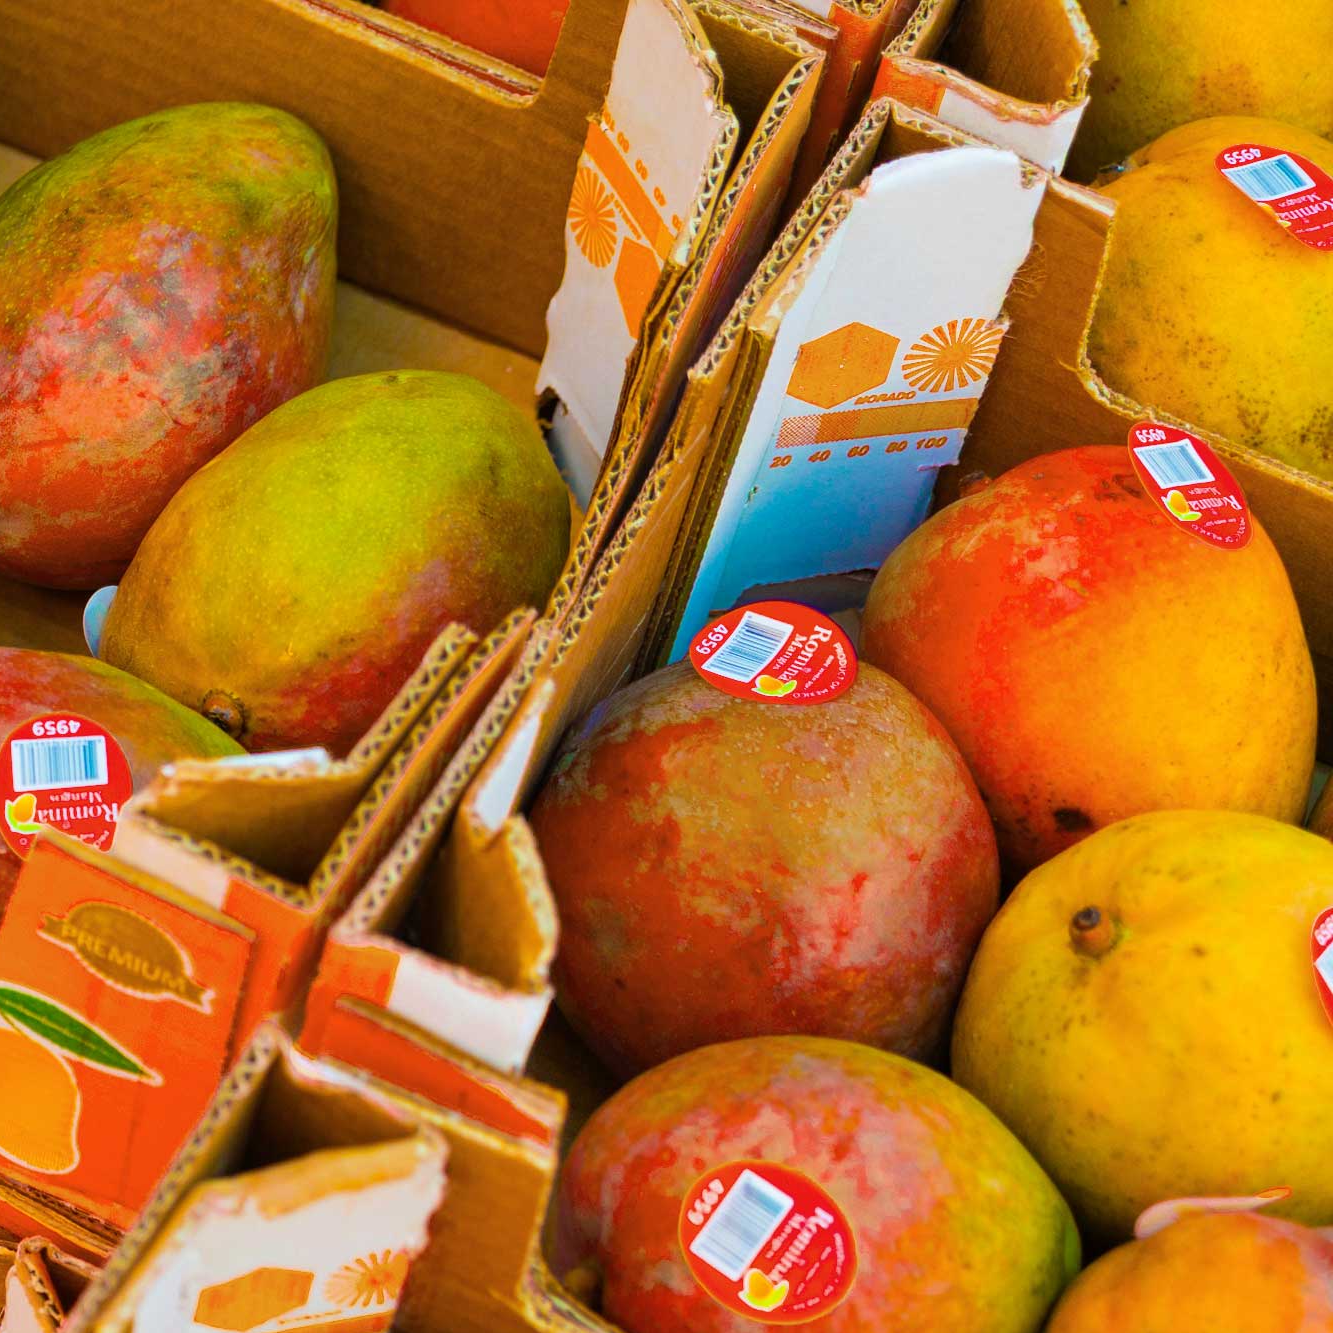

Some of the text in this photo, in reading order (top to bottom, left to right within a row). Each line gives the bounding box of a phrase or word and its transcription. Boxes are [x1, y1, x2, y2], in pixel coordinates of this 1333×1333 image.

[1223, 148, 1261, 165] 4959
[1135, 428, 1166, 443] 4959
[769, 436, 949, 469] 20 40 60 80 100
[1188, 495, 1242, 511] Romina
[695, 624, 729, 655] 4959
[772, 633, 808, 670] Mangos
[778, 625, 833, 681] Romina
[833, 642, 848, 681] PRODUCT
[32, 720, 81, 736] 4959
[50, 791, 102, 803] Mangos
[37, 803, 118, 823] Romina
[61, 922, 186, 991] PREMIUM
